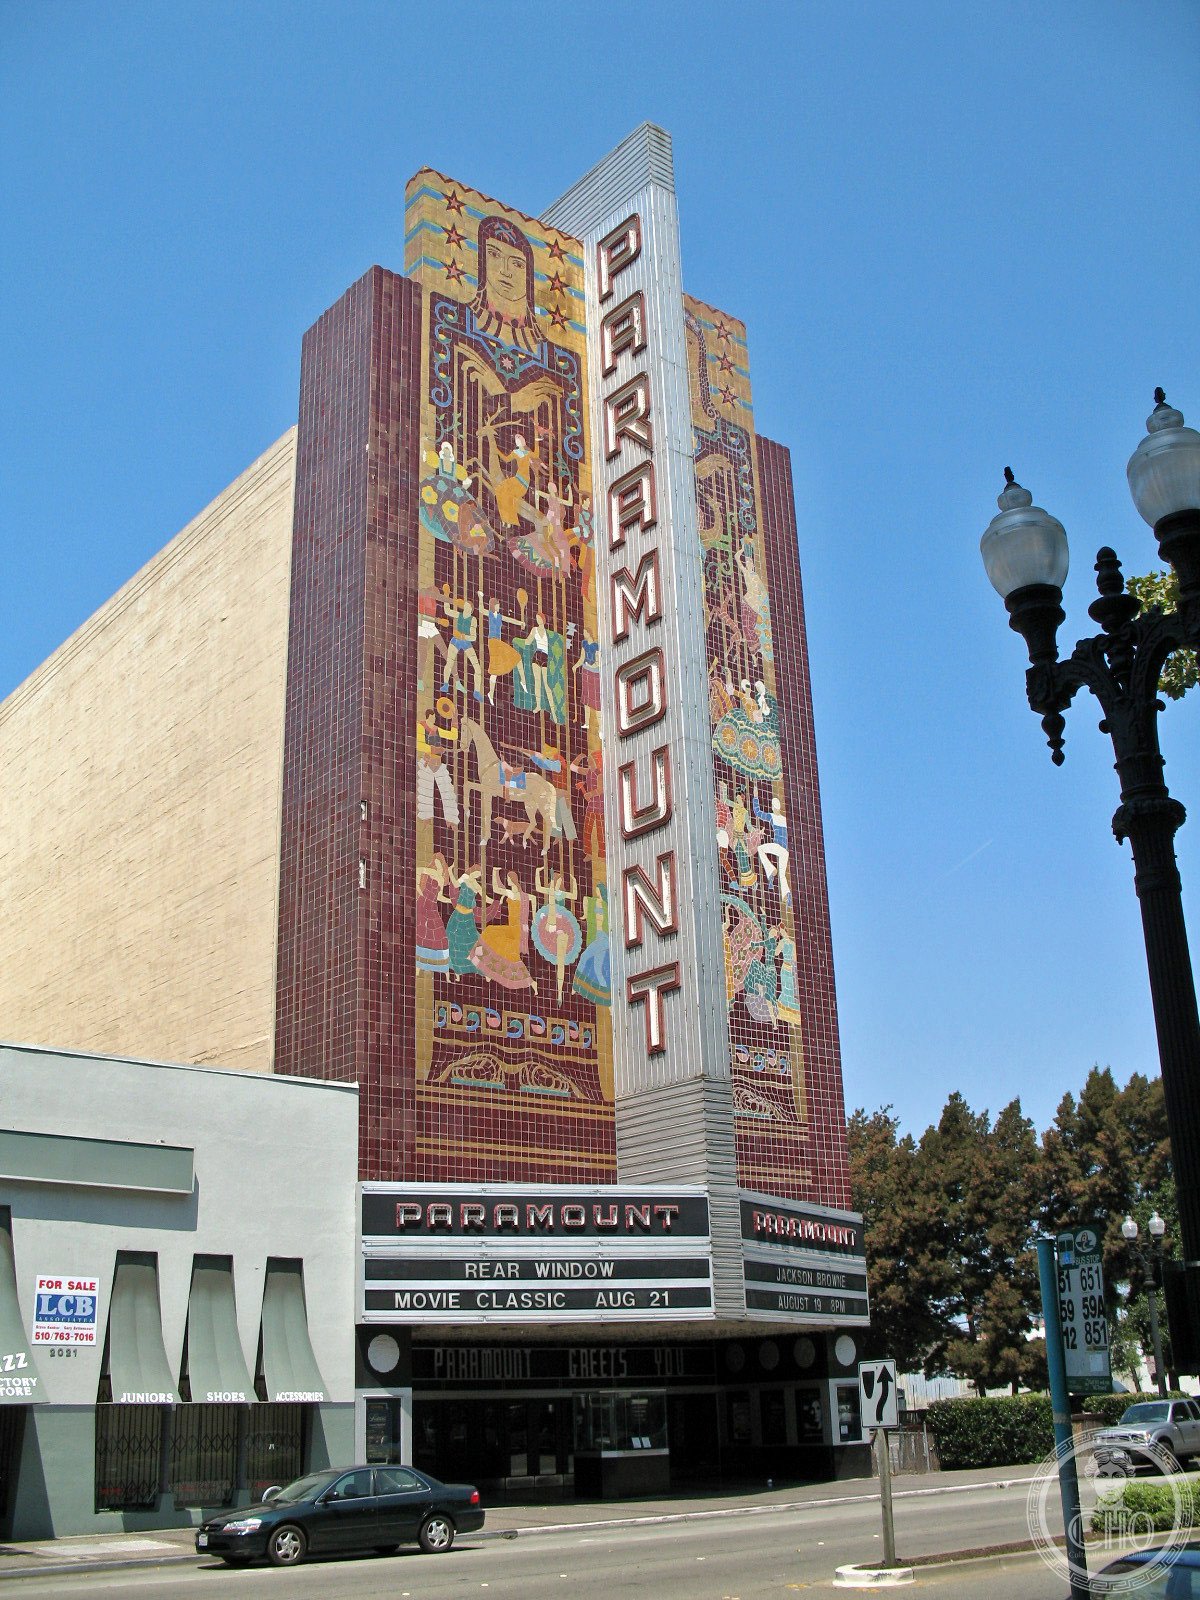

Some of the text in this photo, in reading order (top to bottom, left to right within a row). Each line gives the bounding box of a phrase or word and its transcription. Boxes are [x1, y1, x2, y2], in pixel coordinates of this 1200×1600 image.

[598, 213, 680, 1055] PARAMOUNT
[397, 1203, 679, 1232] PARAMOUNT
[753, 1211, 857, 1246] PARAMOUNT
[1086, 1254, 1100, 1264] STOP
[465, 1262, 615, 1279] REAR WINDOW
[776, 1268, 846, 1288] JACKSON BROWNE
[1080, 1265, 1101, 1291] 651
[39, 1280, 96, 1291] FOR SALE
[39, 1295, 93, 1316] LCB
[394, 1291, 670, 1309] MOVIE CLASSIC AUG 21
[778, 1295, 846, 1313] AUGUST 19 8PM
[1082, 1295, 1106, 1320] 59A
[35, 1332, 94, 1341] 510/763-7016
[1084, 1320, 1107, 1345] 851
[50, 1348, 77, 1357] 2021
[0, 1353, 28, 1372] ZZ
[433, 1348, 684, 1379] PARAMOUNT GREETS YOU
[120, 1392, 173, 1403] JUNIORS
[206, 1391, 246, 1402] SHOES
[275, 1391, 324, 1402] ACCESSORIES
